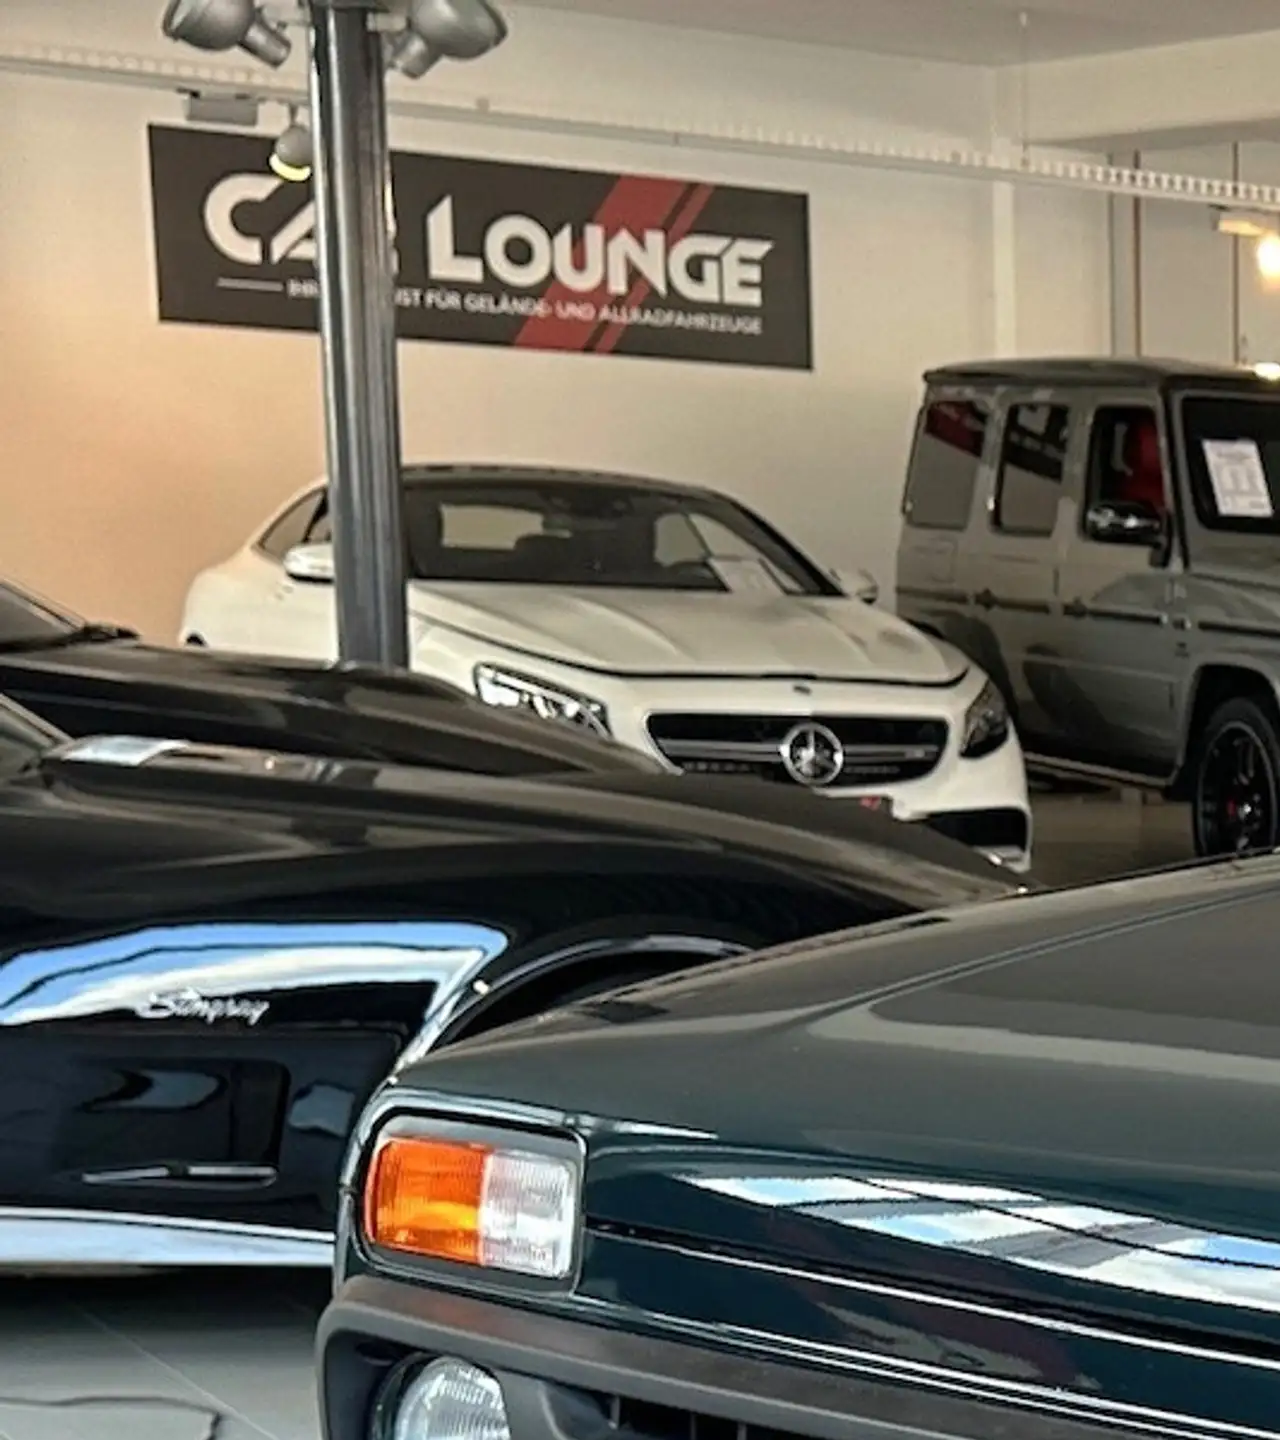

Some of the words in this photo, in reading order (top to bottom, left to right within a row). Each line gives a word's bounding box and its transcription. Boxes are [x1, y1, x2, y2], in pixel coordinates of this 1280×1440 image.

[204, 172, 399, 274] CA
[427, 196, 773, 307] LOUNGE
[555, 302, 597, 321] UND
